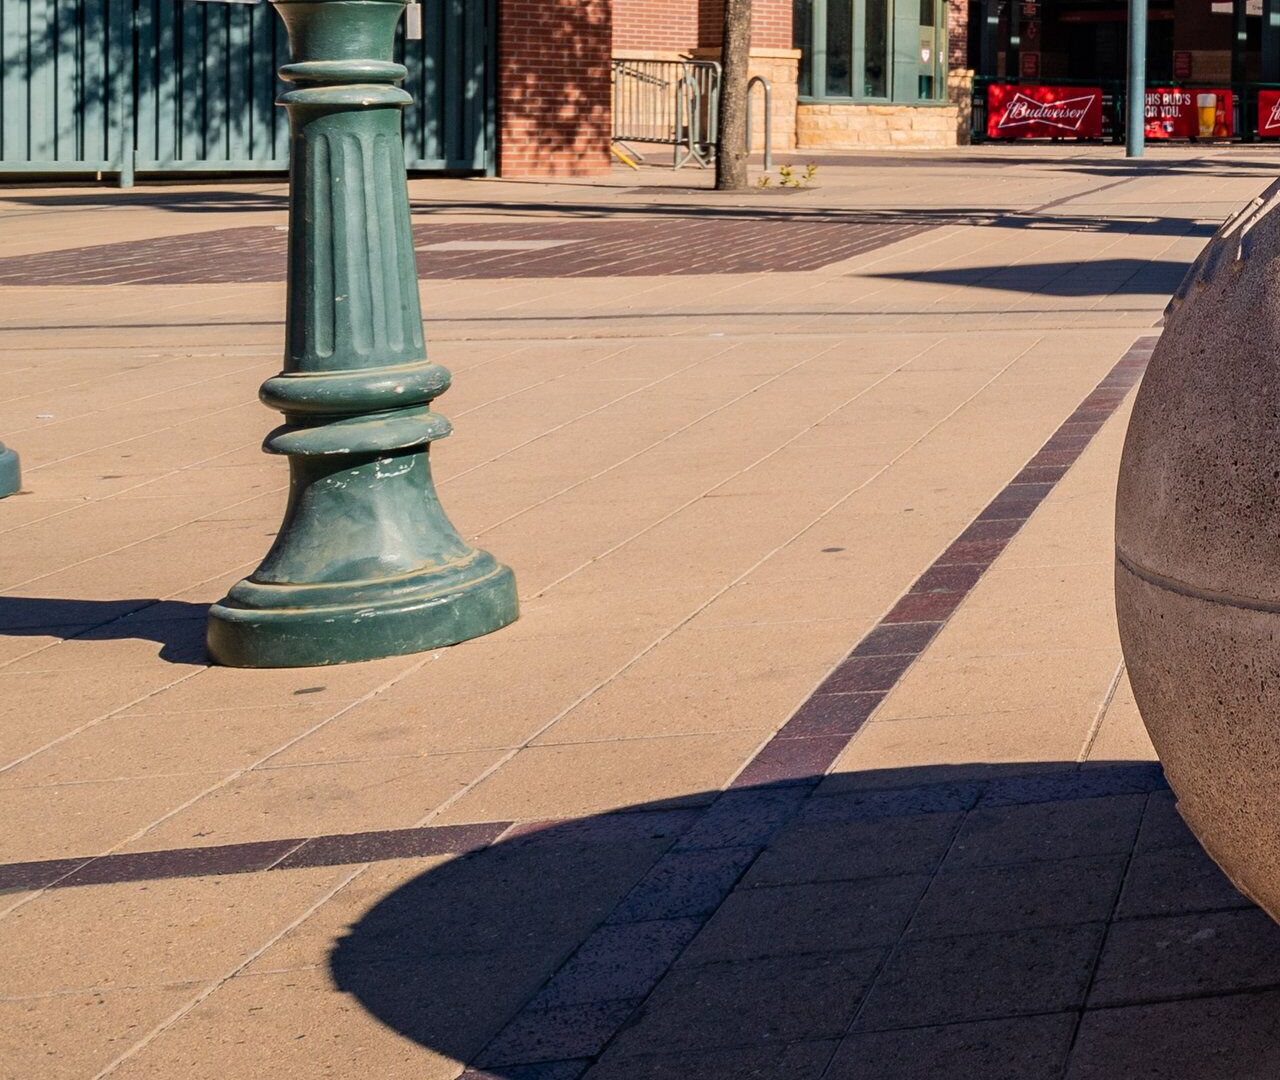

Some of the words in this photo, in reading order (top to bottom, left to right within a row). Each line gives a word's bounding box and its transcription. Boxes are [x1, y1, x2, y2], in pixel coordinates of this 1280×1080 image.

[1145, 93, 1161, 105] HIS
[1162, 93, 1191, 106] BUD'S
[1007, 102, 1084, 118] Budweiser
[1145, 105, 1158, 118] OR
[1160, 106, 1182, 118] YOU.
